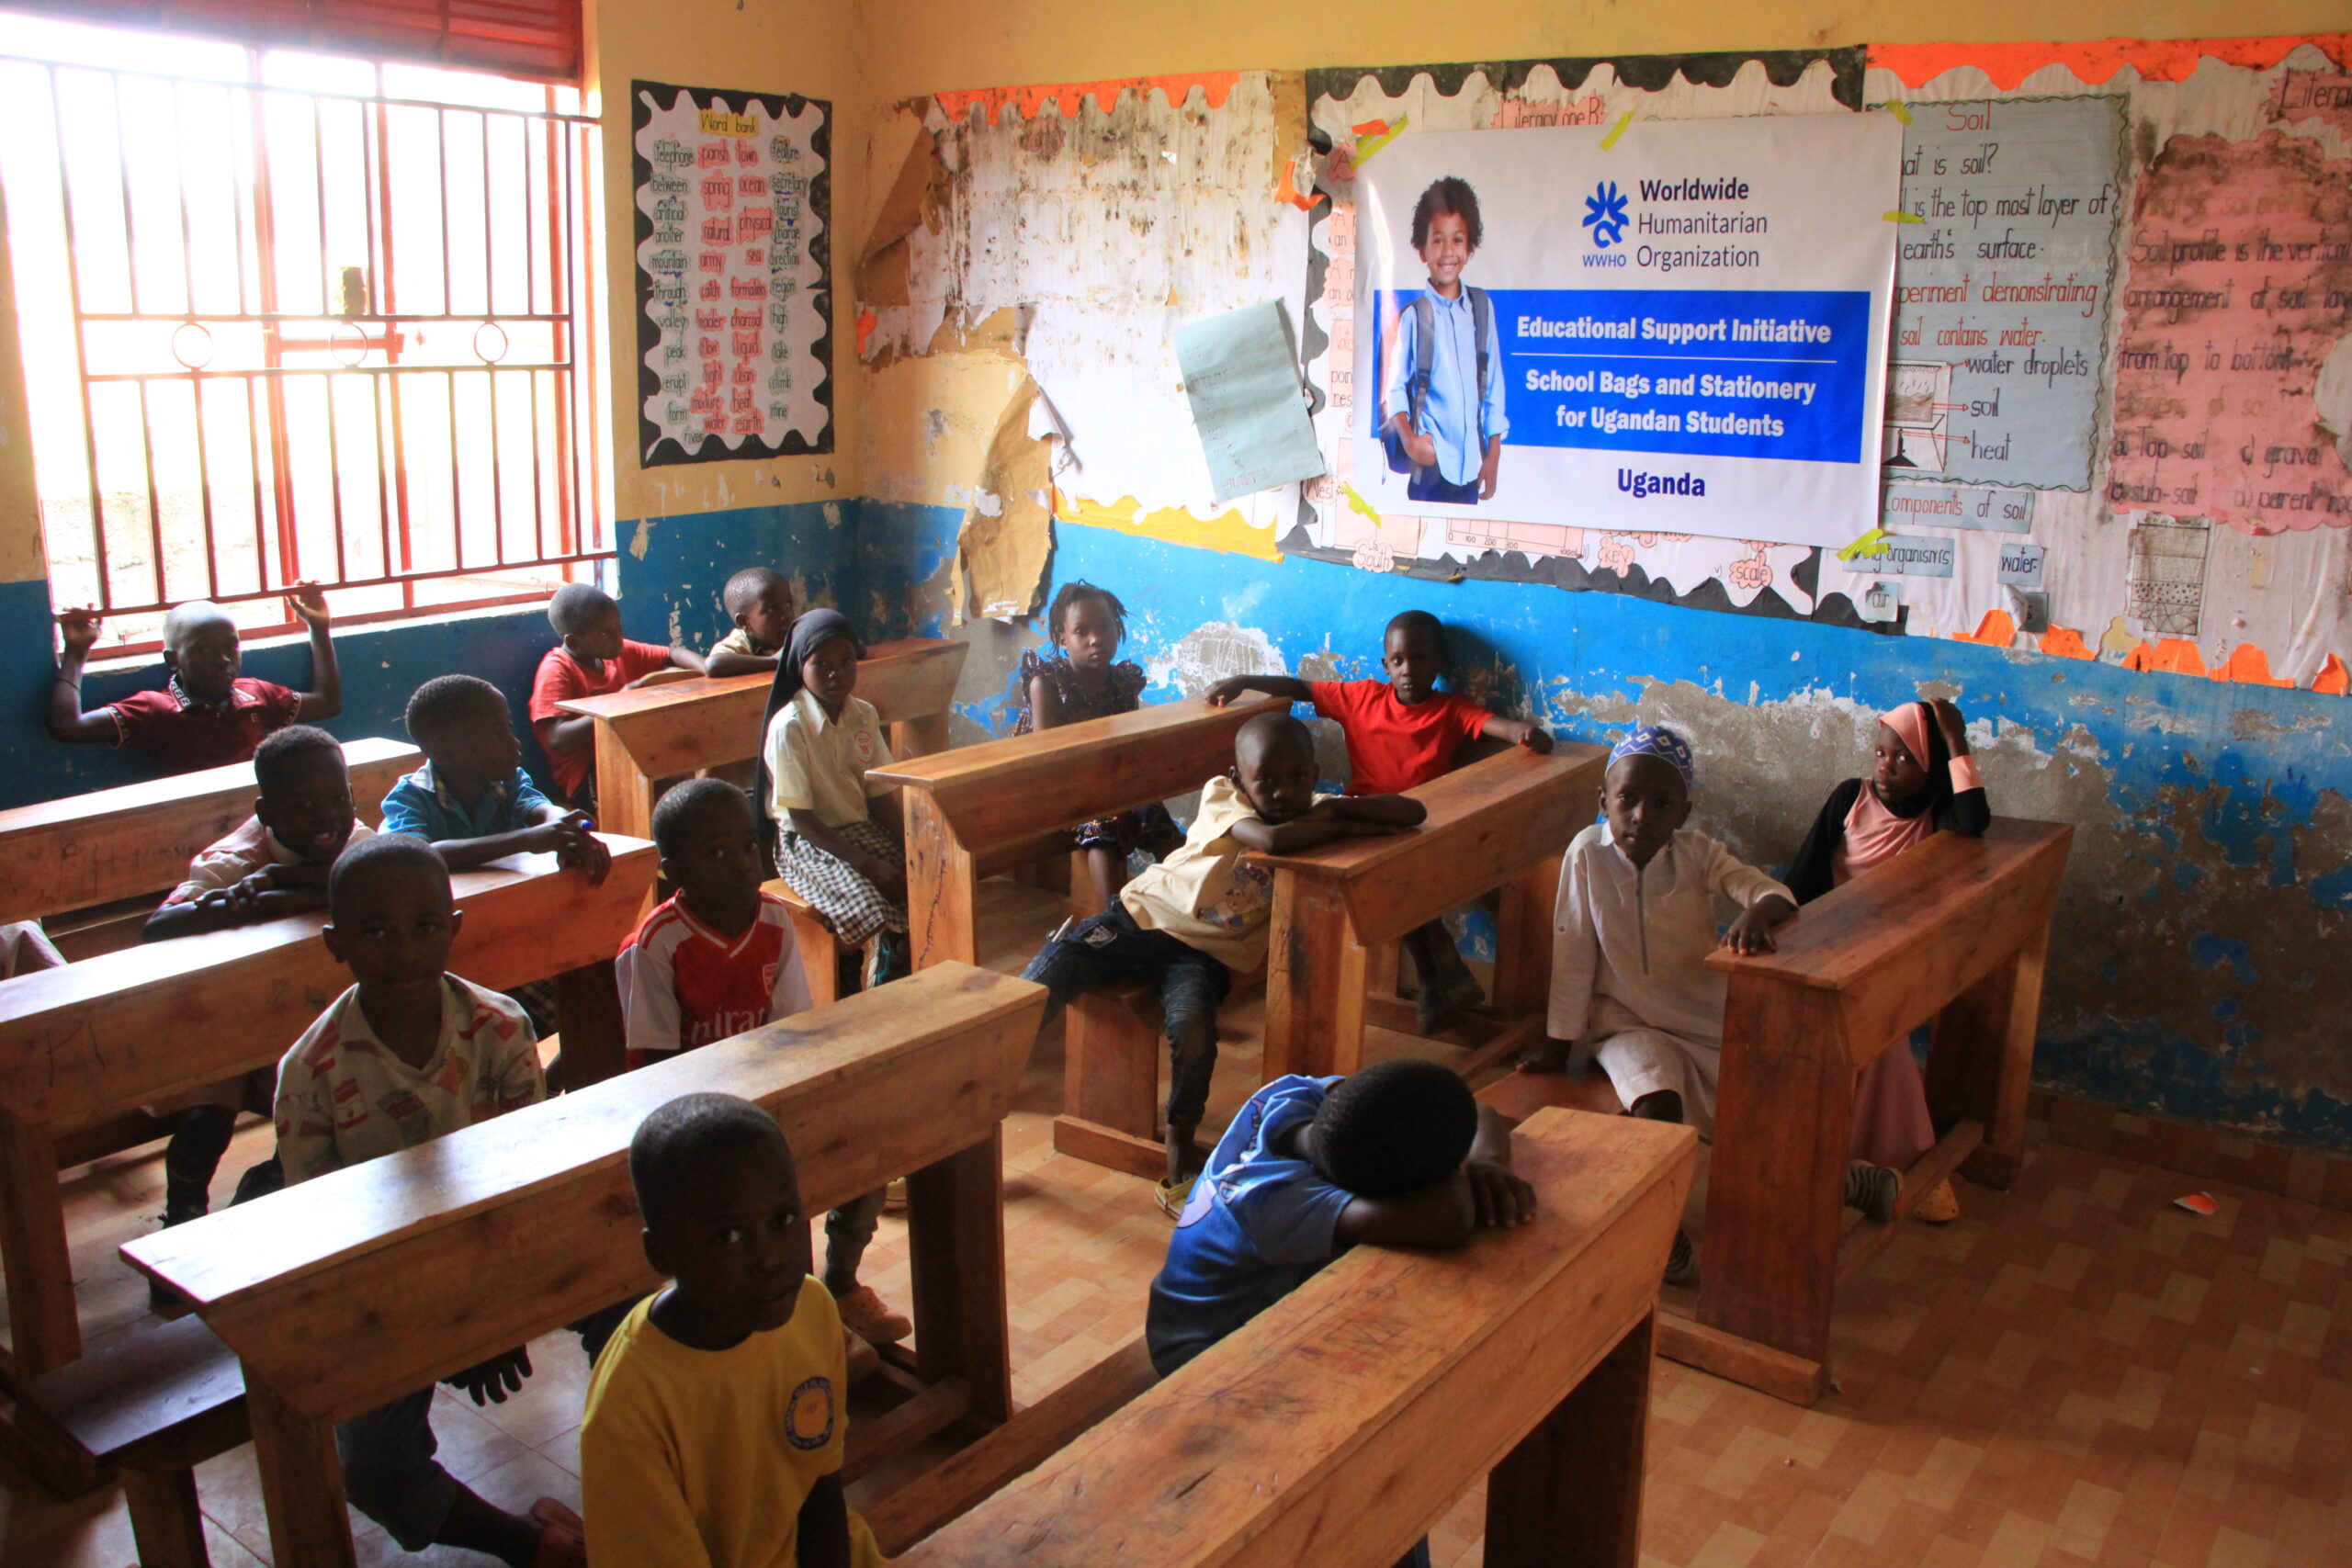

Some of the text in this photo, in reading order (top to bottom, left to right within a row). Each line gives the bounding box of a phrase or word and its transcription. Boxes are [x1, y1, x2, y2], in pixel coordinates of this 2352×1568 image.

[2279, 67, 2352, 108] Litera
[700, 113, 757, 132] Word bank
[1946, 99, 1991, 131] Soil
[1901, 142, 1998, 175] at is soil?
[1640, 177, 1749, 201] Worldwide
[1638, 210, 1768, 234] Humanitarian
[1931, 187, 1956, 217] the
[1961, 189, 1987, 230] top
[1996, 187, 2035, 217] most
[2037, 184, 2080, 229] layer
[2088, 184, 2112, 215] of
[1582, 254, 1627, 267] WWHO
[1636, 244, 1760, 272] Organization
[2256, 228, 2283, 263] the
[1982, 271, 2098, 318] demonstrating
[1517, 316, 1832, 344] Educational Support Initiative
[1900, 316, 1923, 346] soil
[1937, 316, 1988, 346] contains
[1330, 370, 1353, 394] poin
[1968, 346, 2088, 389] water droplets
[1333, 393, 1353, 407] res
[1526, 369, 1816, 405] School Bags and Stationery
[1971, 387, 2000, 417] soil
[1556, 405, 1784, 436] for Ugandan Students
[1971, 430, 2012, 461] heat
[1618, 468, 1706, 498] Uganda
[1976, 491, 1996, 518] of
[2003, 492, 2029, 520] soil
[1604, 538, 1630, 575] key
[1736, 555, 1769, 582] scale
